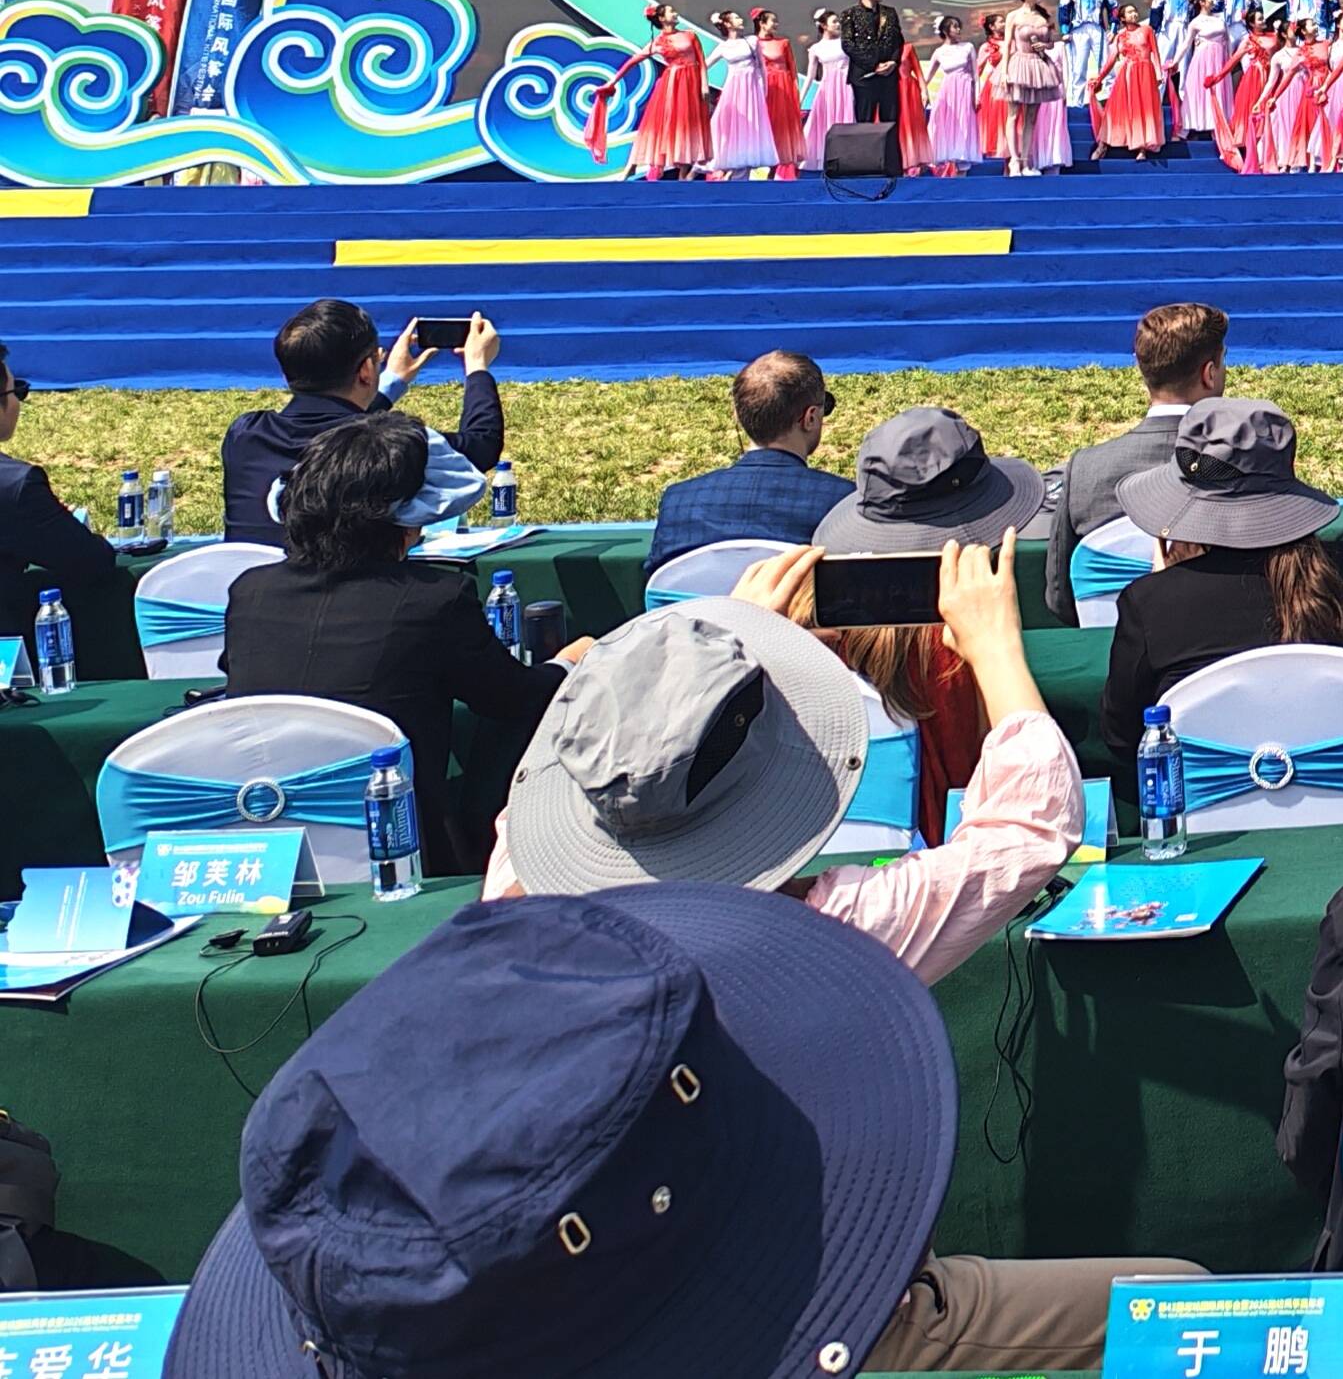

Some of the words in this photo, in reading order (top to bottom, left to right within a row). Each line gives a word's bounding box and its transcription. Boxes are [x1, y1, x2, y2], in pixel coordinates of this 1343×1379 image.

[171, 857, 264, 888] 邹芙林
[177, 890, 206, 906] Zou
[208, 888, 245, 905] Fulin
[1177, 1324, 1309, 1378] 于鹏
